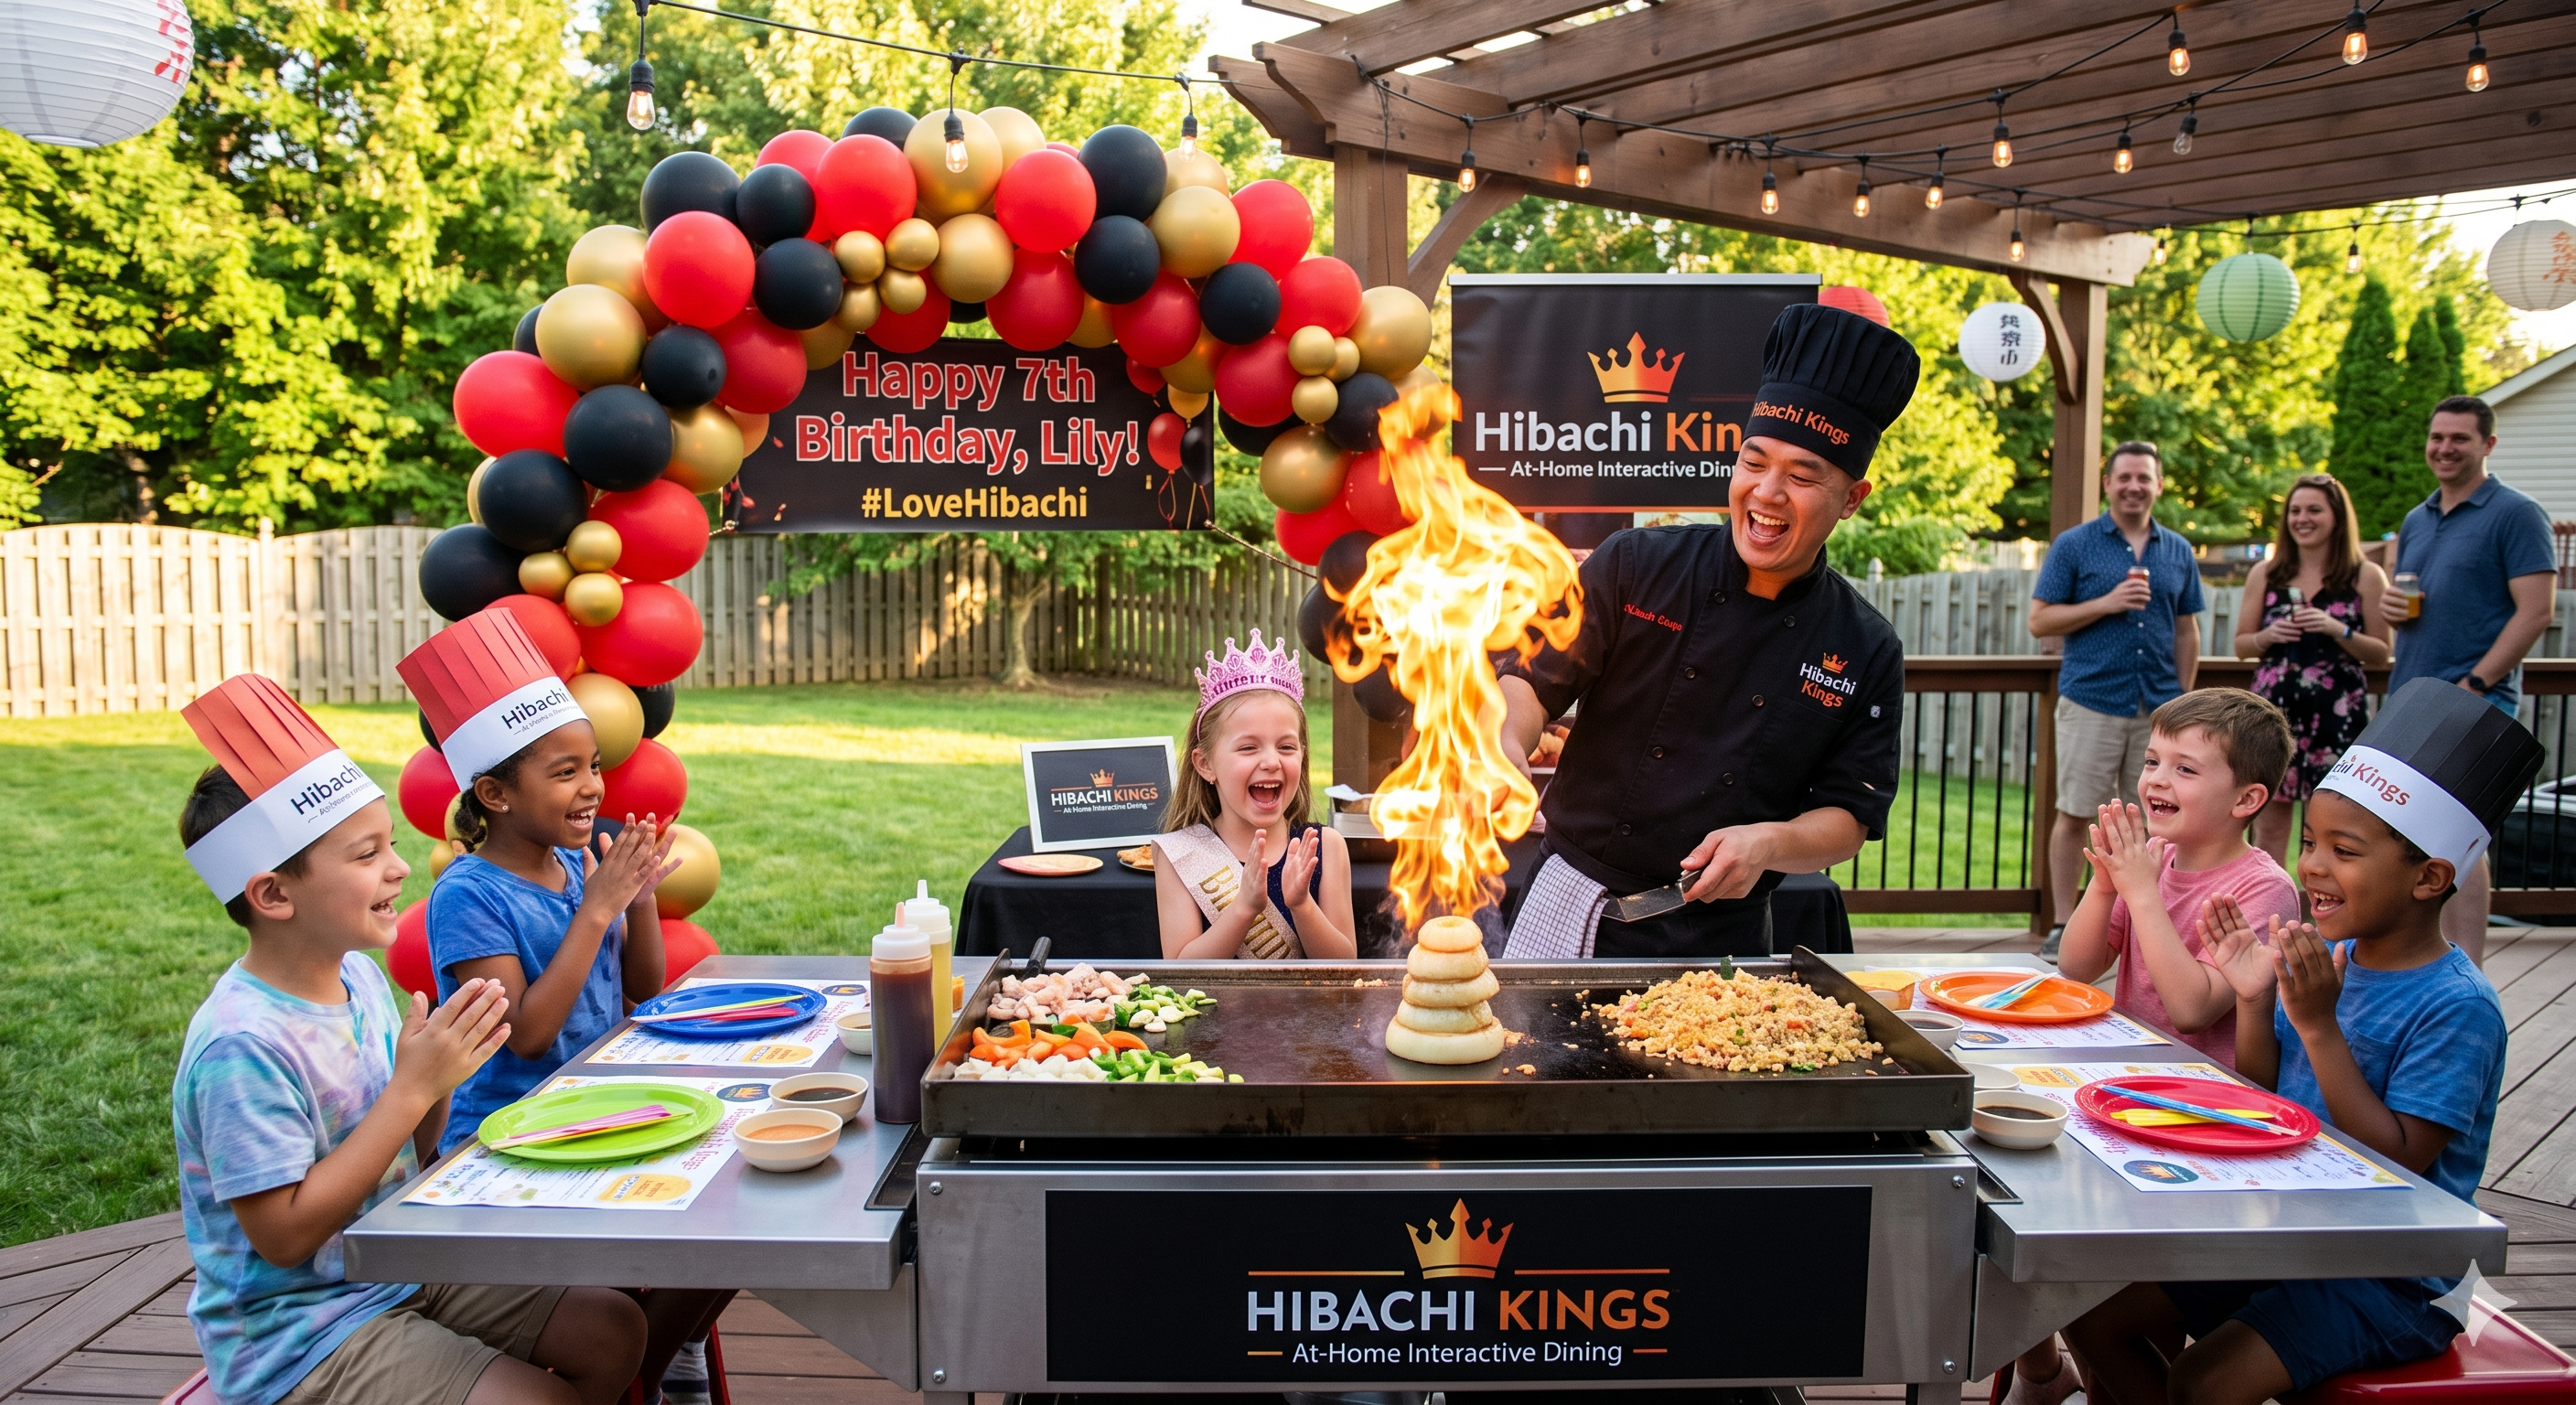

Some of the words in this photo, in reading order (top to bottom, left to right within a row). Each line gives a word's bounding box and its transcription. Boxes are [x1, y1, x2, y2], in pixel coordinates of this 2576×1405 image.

[843, 350, 1005, 412] Happy
[1015, 356, 1096, 402] 7th
[796, 411, 1029, 476] Birthday,
[1041, 416, 1140, 477] Lily!
[1476, 411, 1652, 452] Hibachi
[1666, 411, 1743, 452] Kin
[1804, 411, 1850, 445] Kings
[1509, 460, 1594, 477] At-Home
[1598, 460, 1696, 477] Interactive
[1700, 460, 1736, 477] Din
[861, 487, 1088, 518] #LoveHibachi
[1799, 662, 1857, 695] Hibachi
[500, 688, 569, 729] Hibachi
[290, 762, 364, 815] Hibachi
[1050, 789, 1112, 806] HIBACHI
[1113, 788, 1159, 802] KINGS
[2352, 763, 2410, 806] Kings
[1248, 1289, 1475, 1332] HIBACHI
[1499, 1289, 1670, 1331] KINGS
[1292, 1343, 1401, 1363] At-Home
[1409, 1341, 1537, 1363] Interactive
[1544, 1341, 1623, 1367] Dining
